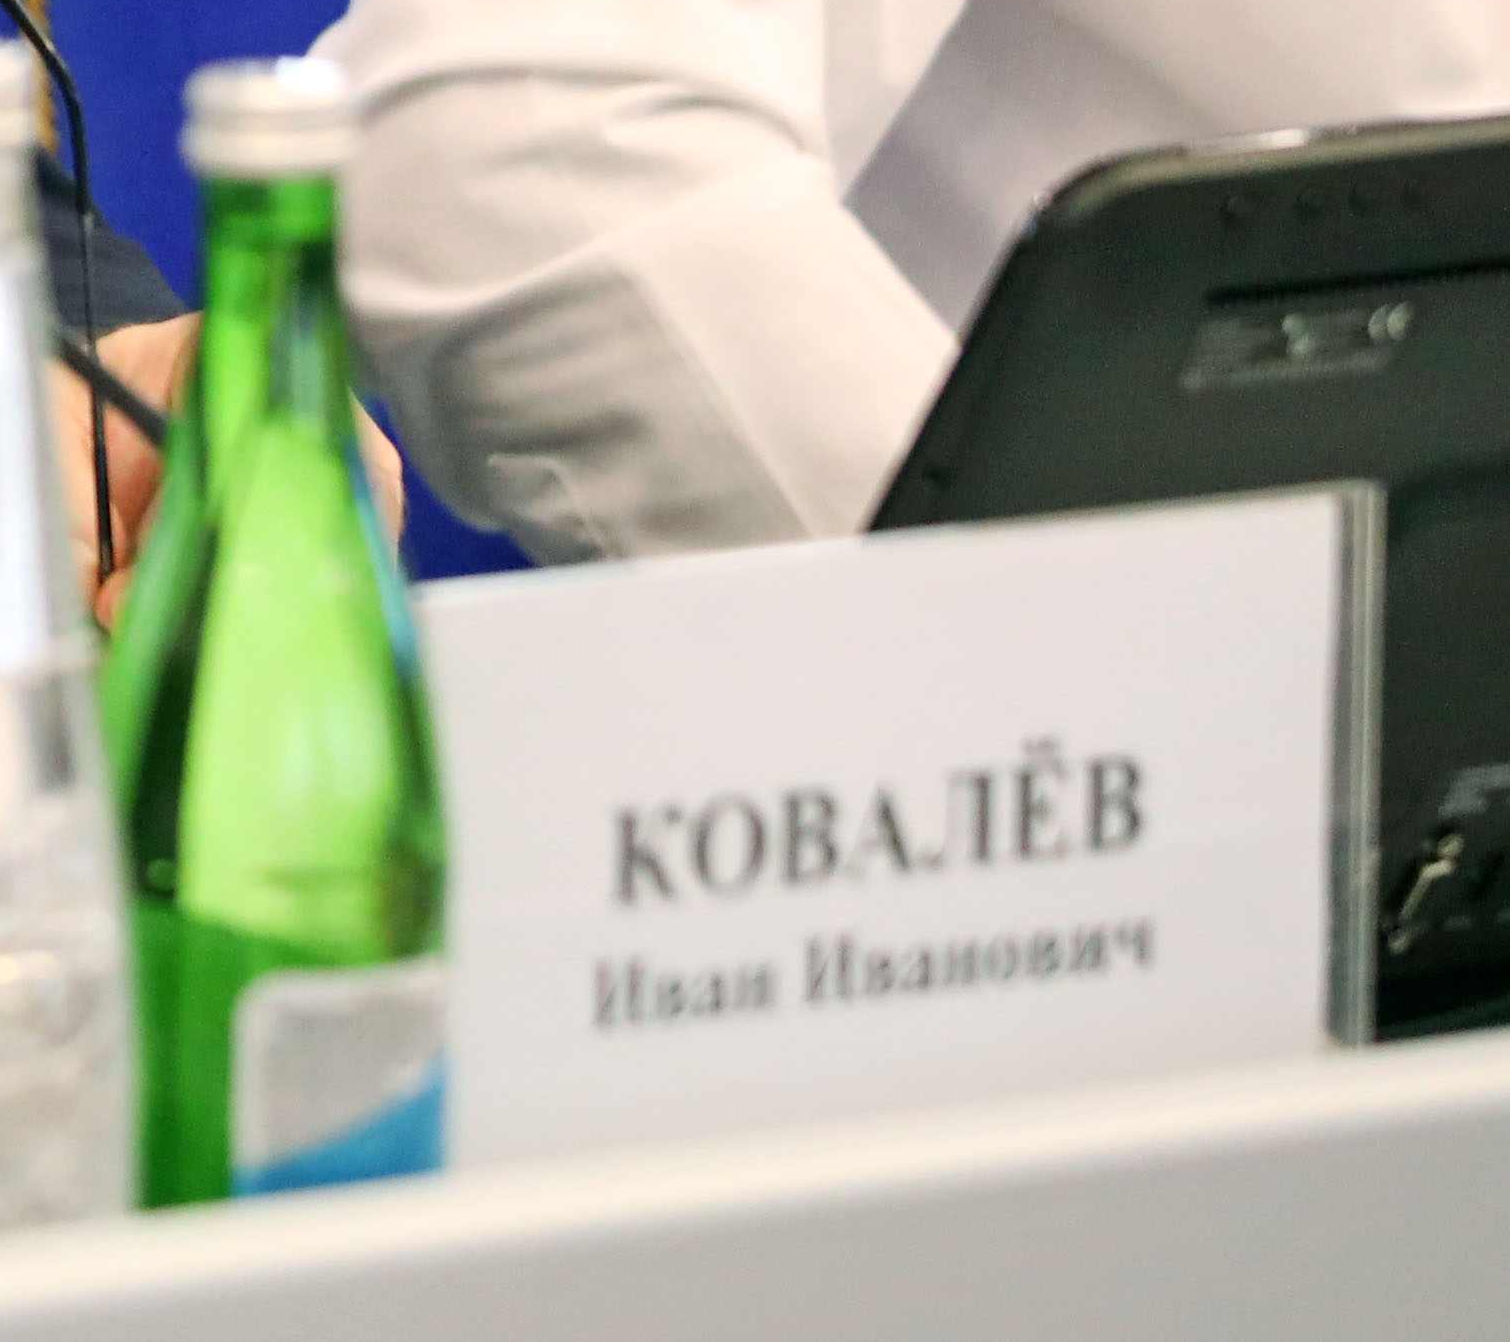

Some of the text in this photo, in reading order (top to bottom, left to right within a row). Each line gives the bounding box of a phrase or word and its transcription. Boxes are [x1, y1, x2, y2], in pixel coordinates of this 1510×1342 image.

[609, 735, 1147, 905] КОВАЛЁВ
[593, 917, 1154, 1031] Иван Иванович
